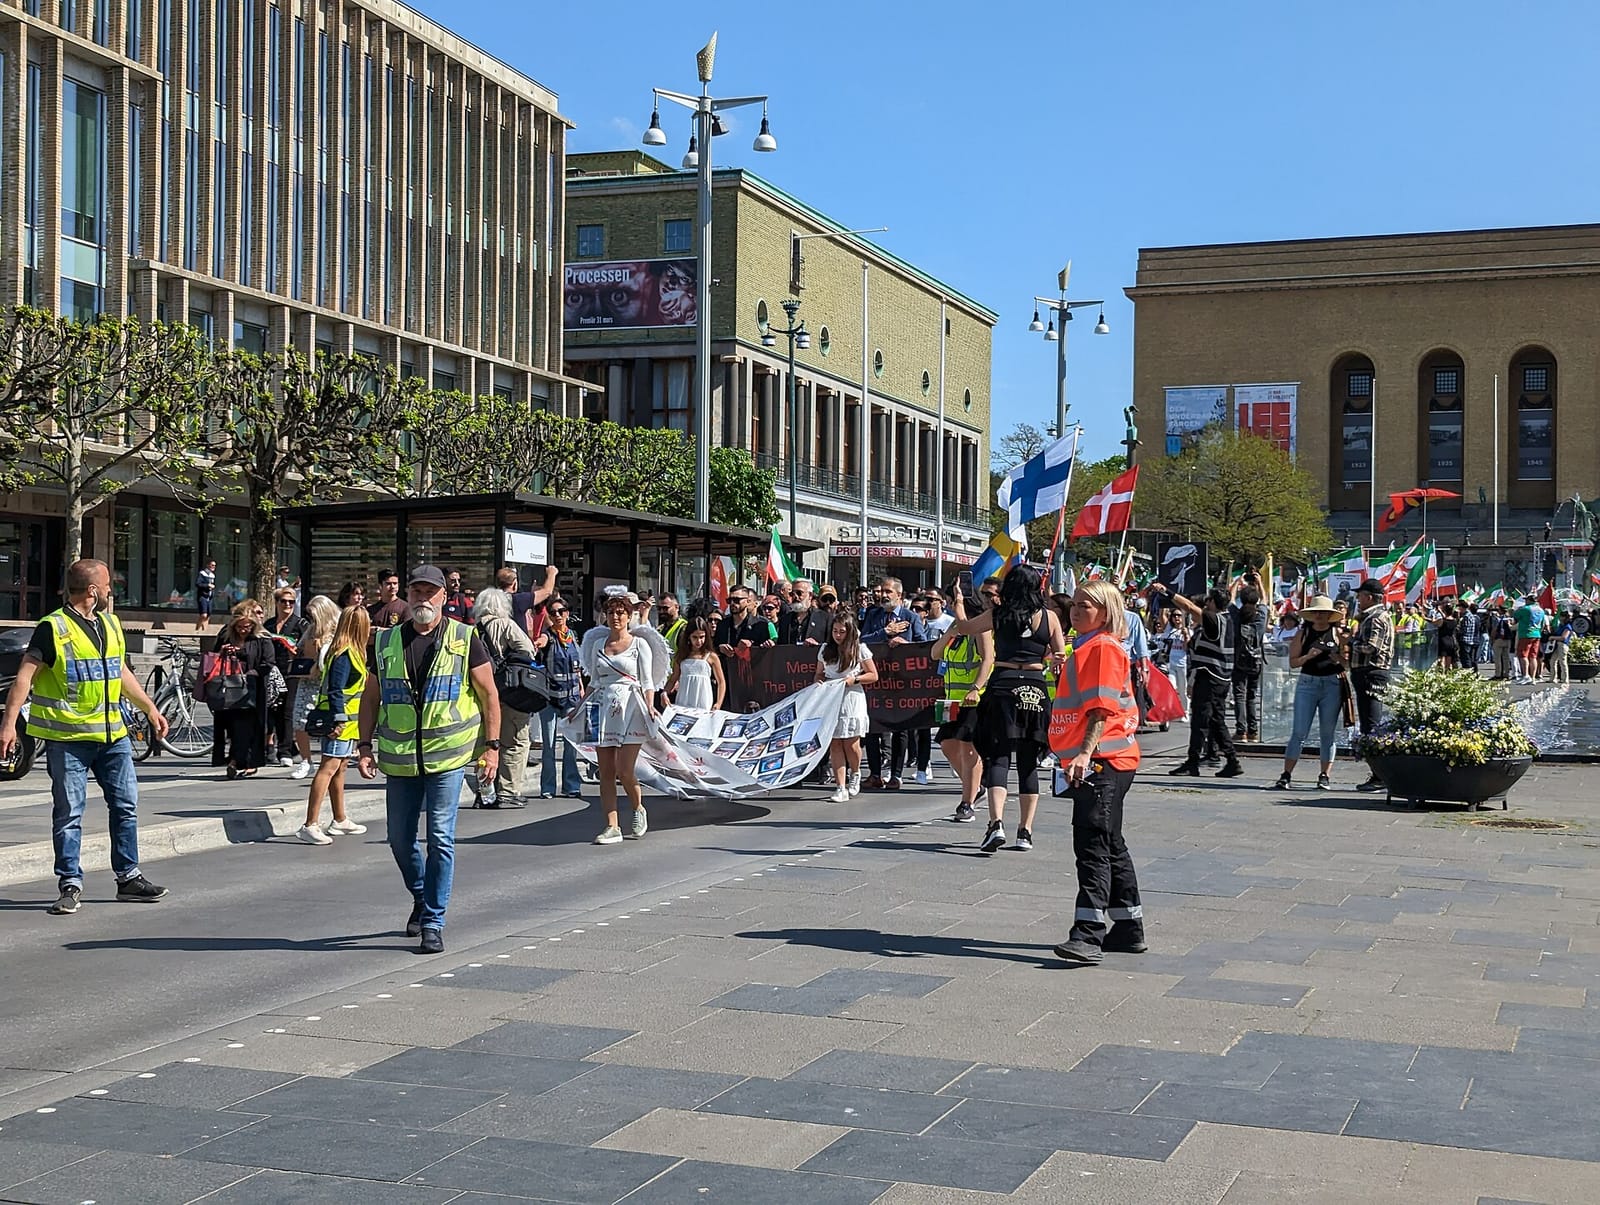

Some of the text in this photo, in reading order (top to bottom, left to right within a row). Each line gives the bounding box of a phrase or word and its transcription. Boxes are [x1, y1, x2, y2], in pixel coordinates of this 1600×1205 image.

[565, 267, 630, 284] Processen
[506, 533, 514, 556] A
[836, 546, 902, 557] PROESSEN
[763, 680, 786, 693] The
[910, 678, 921, 689] is
[899, 696, 938, 710] corps
